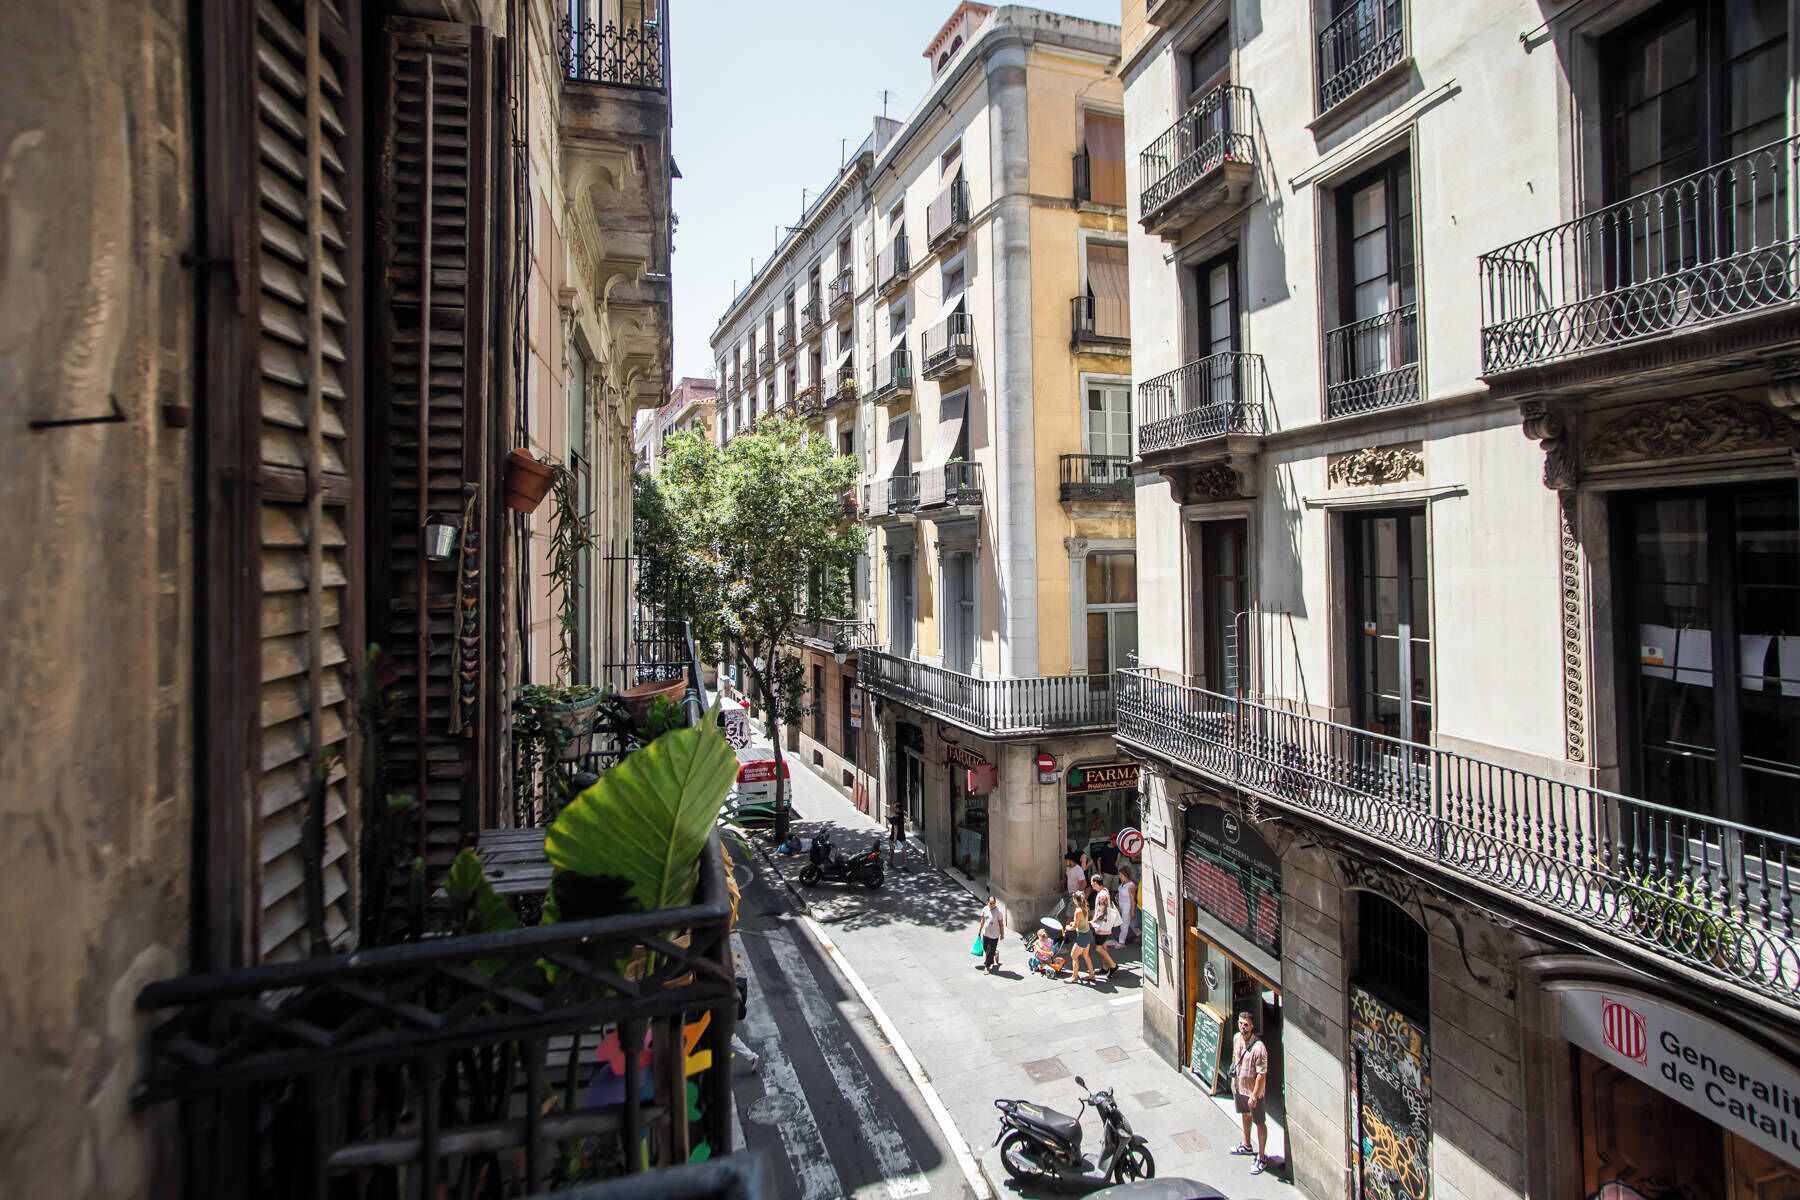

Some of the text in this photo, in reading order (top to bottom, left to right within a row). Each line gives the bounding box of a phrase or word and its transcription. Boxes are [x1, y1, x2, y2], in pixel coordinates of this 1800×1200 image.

[1086, 767, 1138, 782] FARMA
[1659, 1030, 1800, 1120] Generalit
[1661, 1062, 1694, 1091] de
